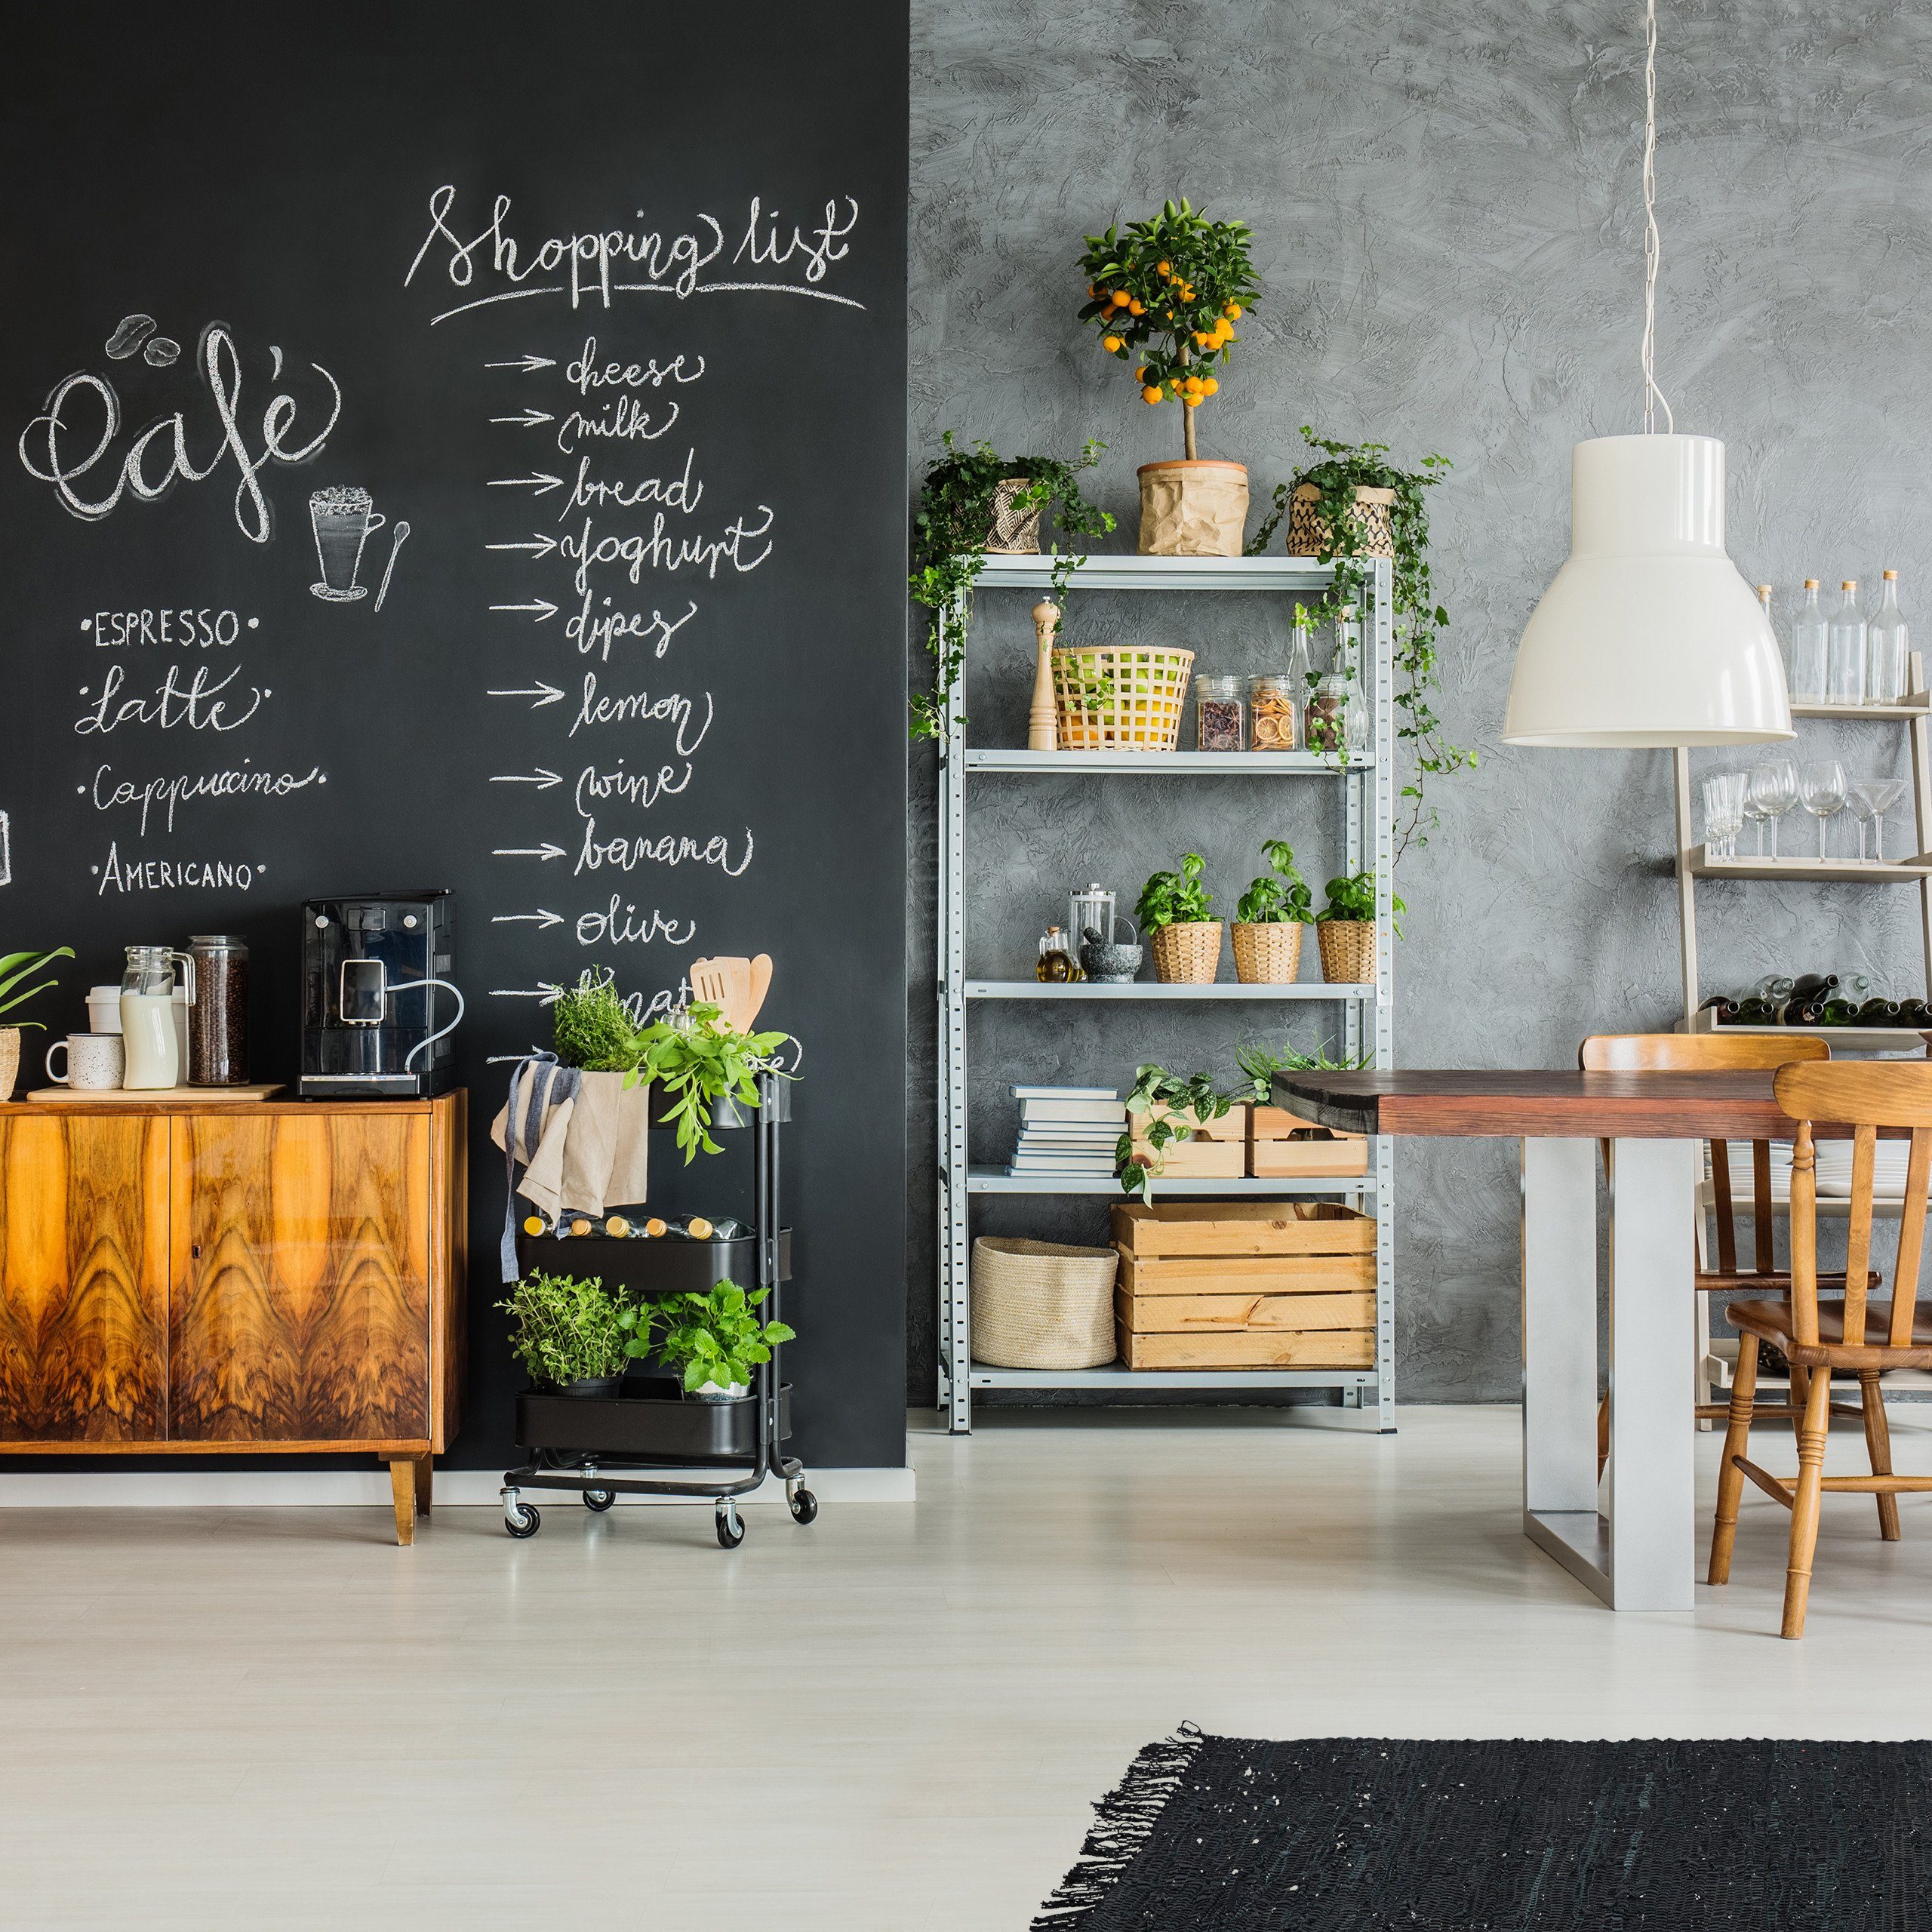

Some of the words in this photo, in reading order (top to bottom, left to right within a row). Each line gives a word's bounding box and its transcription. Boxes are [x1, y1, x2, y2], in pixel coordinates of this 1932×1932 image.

[405, 184, 723, 310] Shopping
[732, 195, 860, 283] list
[566, 336, 706, 396] cheese
[18, 328, 342, 544] Café
[558, 394, 680, 454] milk
[558, 447, 704, 522] bread
[560, 504, 774, 596] yoghurt
[95, 608, 239, 648] ESPRESSO
[74, 663, 260, 735] Latte
[568, 671, 714, 756] lemon
[574, 758, 693, 818] wine
[98, 841, 252, 896] AMERICANO
[574, 817, 754, 877] banana
[576, 893, 697, 946] olive
